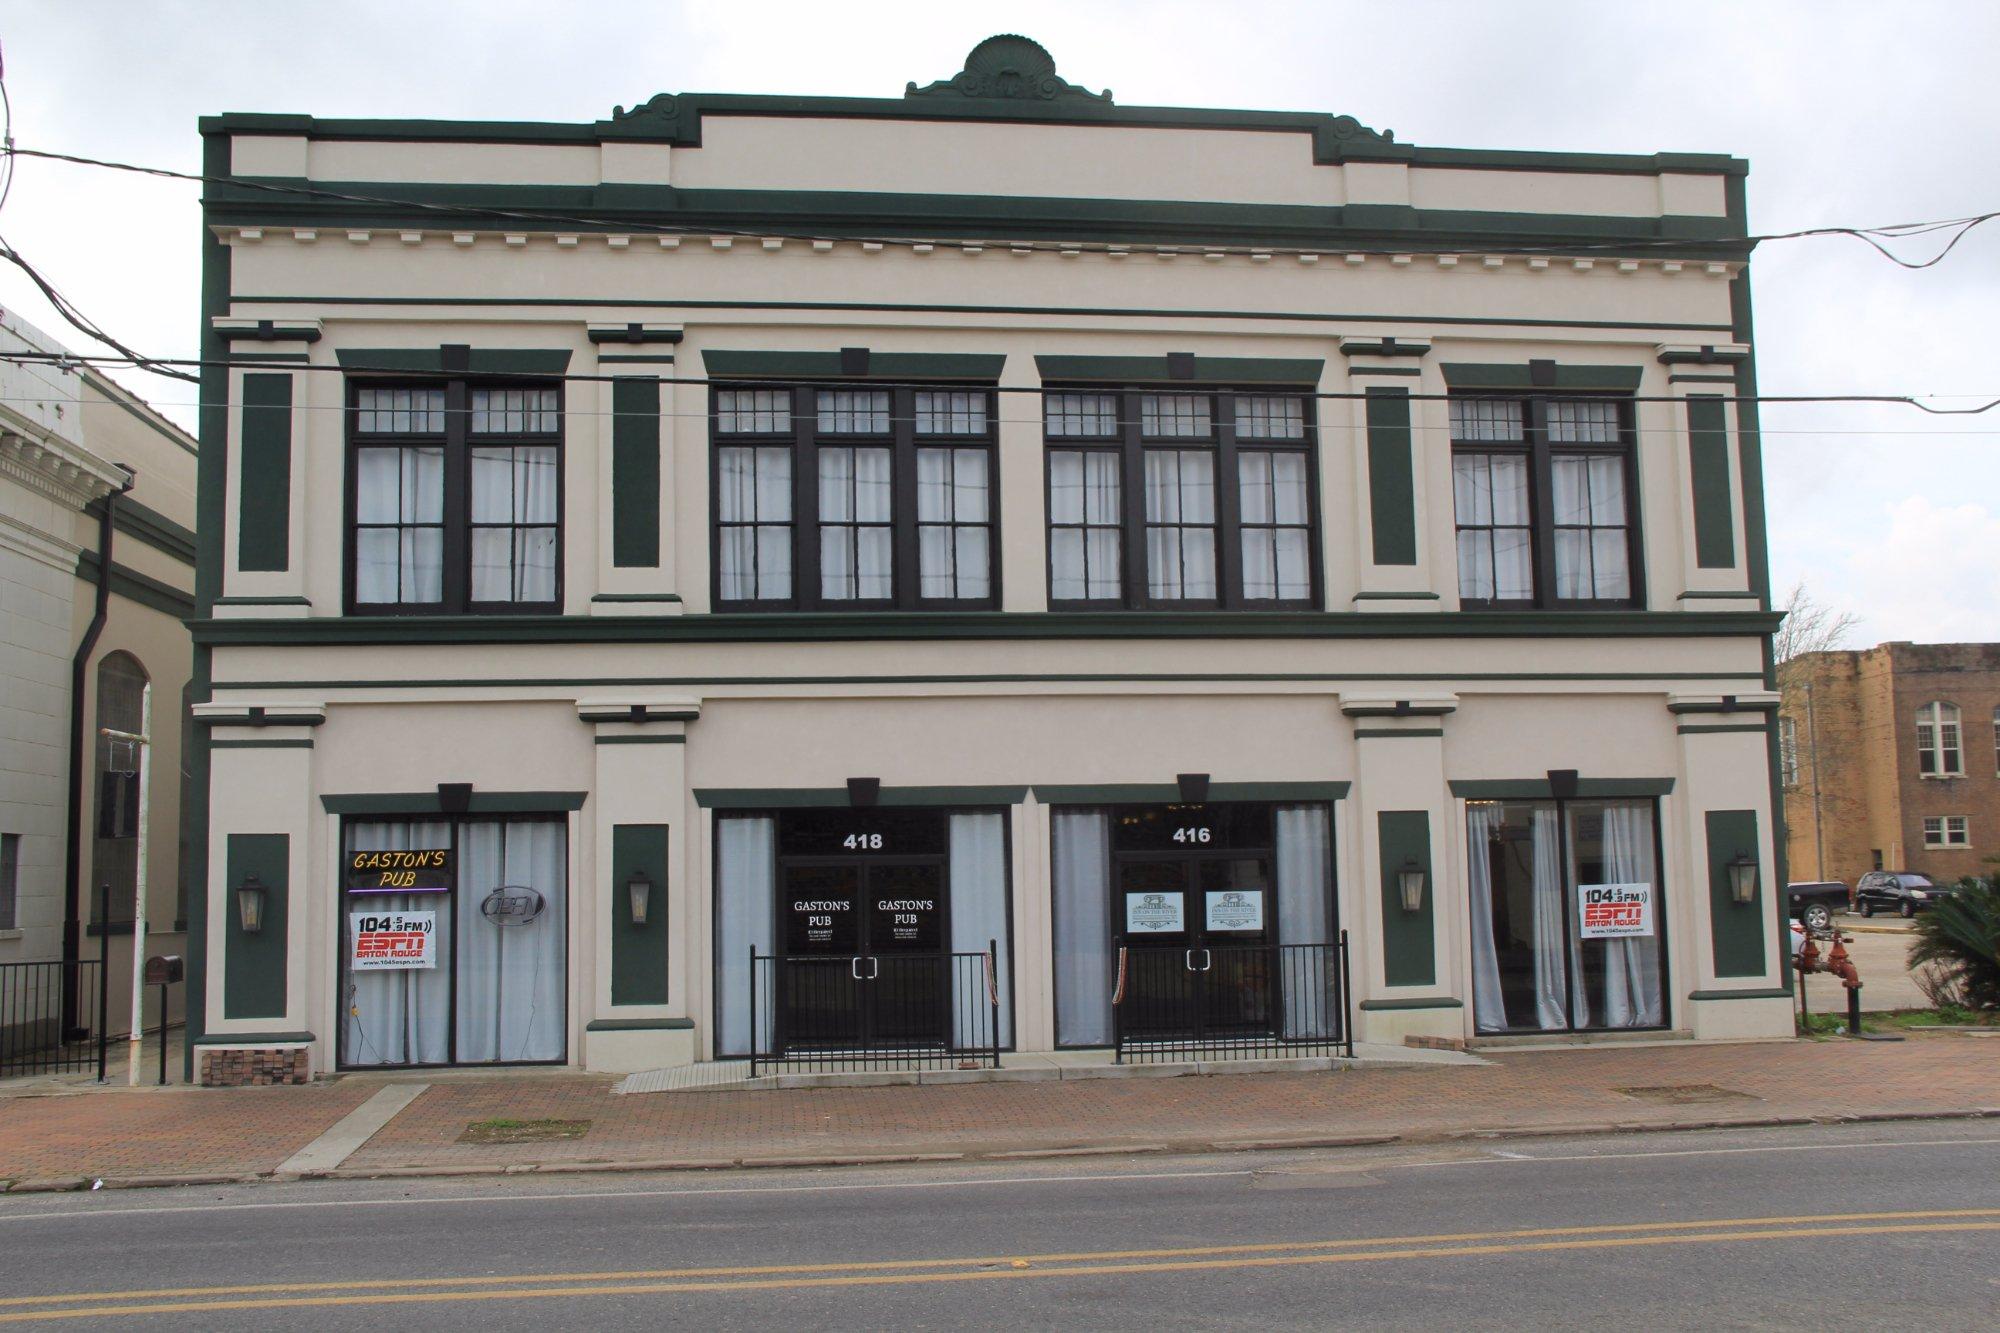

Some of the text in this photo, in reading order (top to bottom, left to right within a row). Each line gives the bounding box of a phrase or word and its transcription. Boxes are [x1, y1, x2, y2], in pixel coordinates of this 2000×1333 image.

[843, 833, 883, 850] 418
[1173, 827, 1211, 843] 416
[354, 851, 445, 868] GASTON'S
[379, 872, 416, 887] PUB
[1585, 889, 1613, 903] 104
[1624, 893, 1640, 902] FM
[794, 901, 850, 912] GASTON'S
[878, 900, 933, 911] GASTON'S
[1585, 902, 1641, 920] ESPN
[359, 917, 391, 932] 104
[404, 922, 423, 931] FM
[809, 916, 832, 926] PUB
[895, 914, 917, 924] PUB
[357, 932, 425, 950] ESPN
[356, 949, 423, 958] BATON ROUGE
